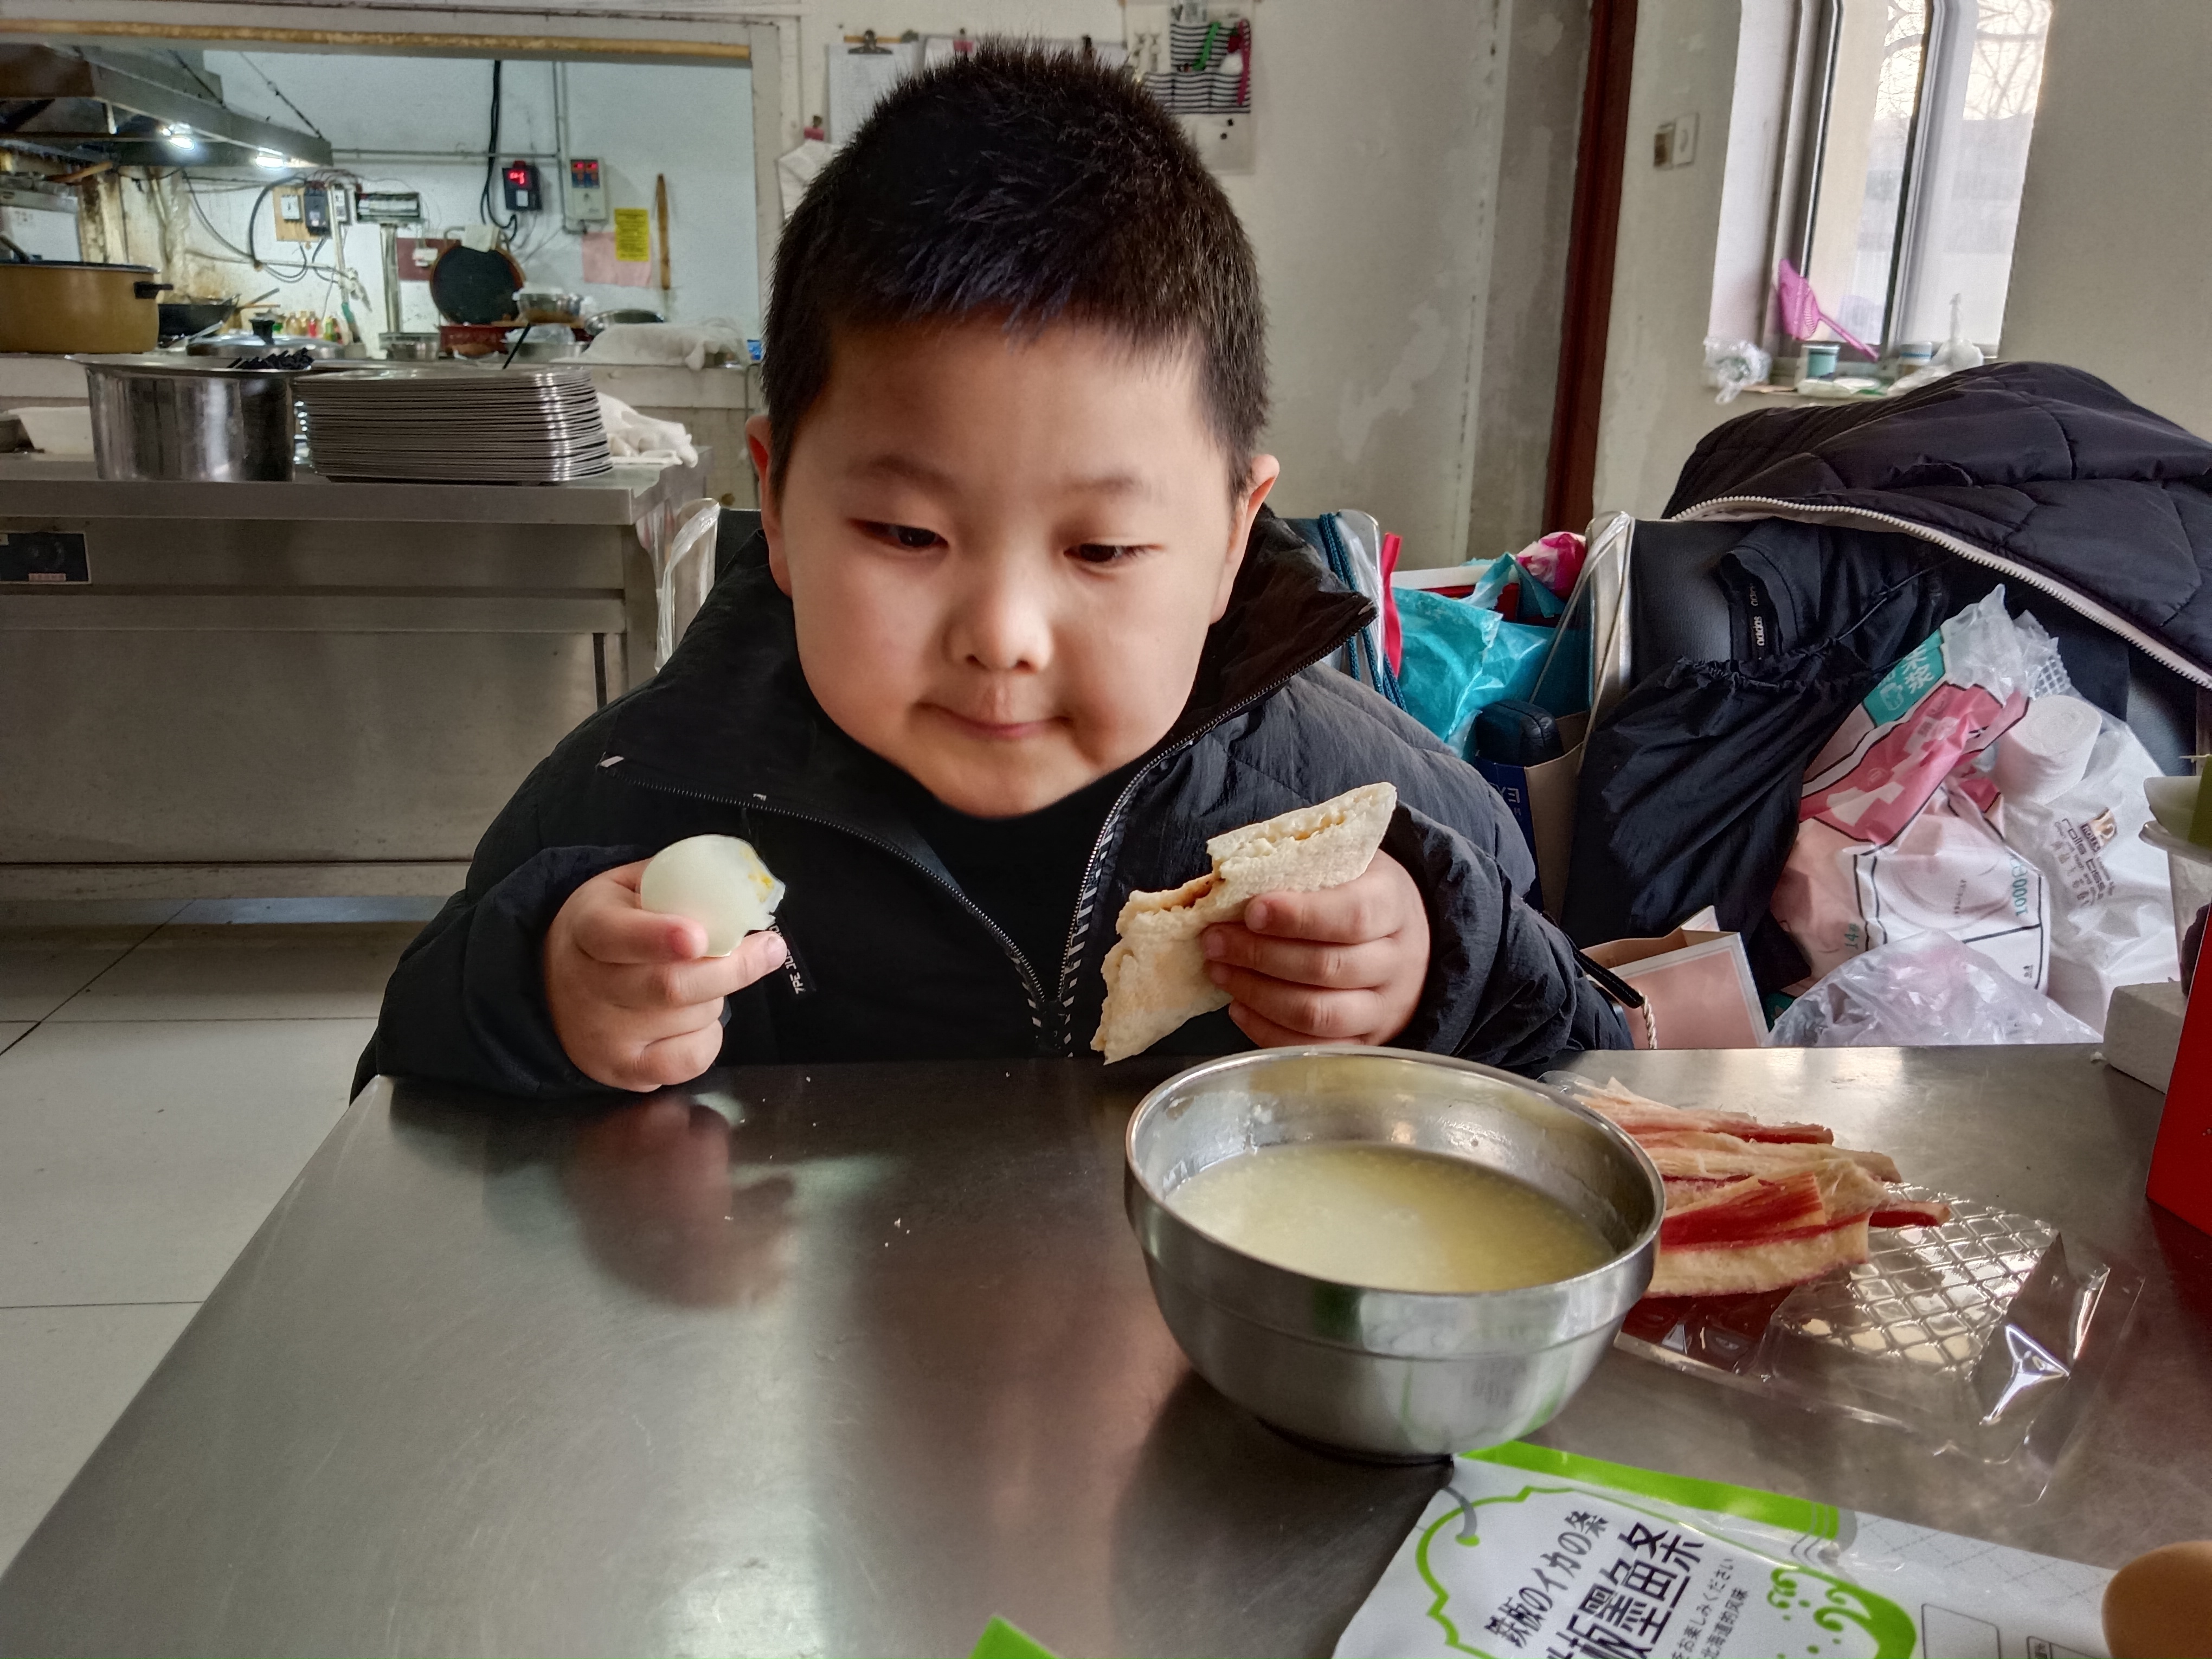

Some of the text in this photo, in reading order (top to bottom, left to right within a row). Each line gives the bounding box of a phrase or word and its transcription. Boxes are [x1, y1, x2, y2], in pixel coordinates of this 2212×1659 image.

[1484, 1510, 1609, 1649] 鉄板のイカの条
[1545, 1522, 1705, 1659] 板墨鱼条
